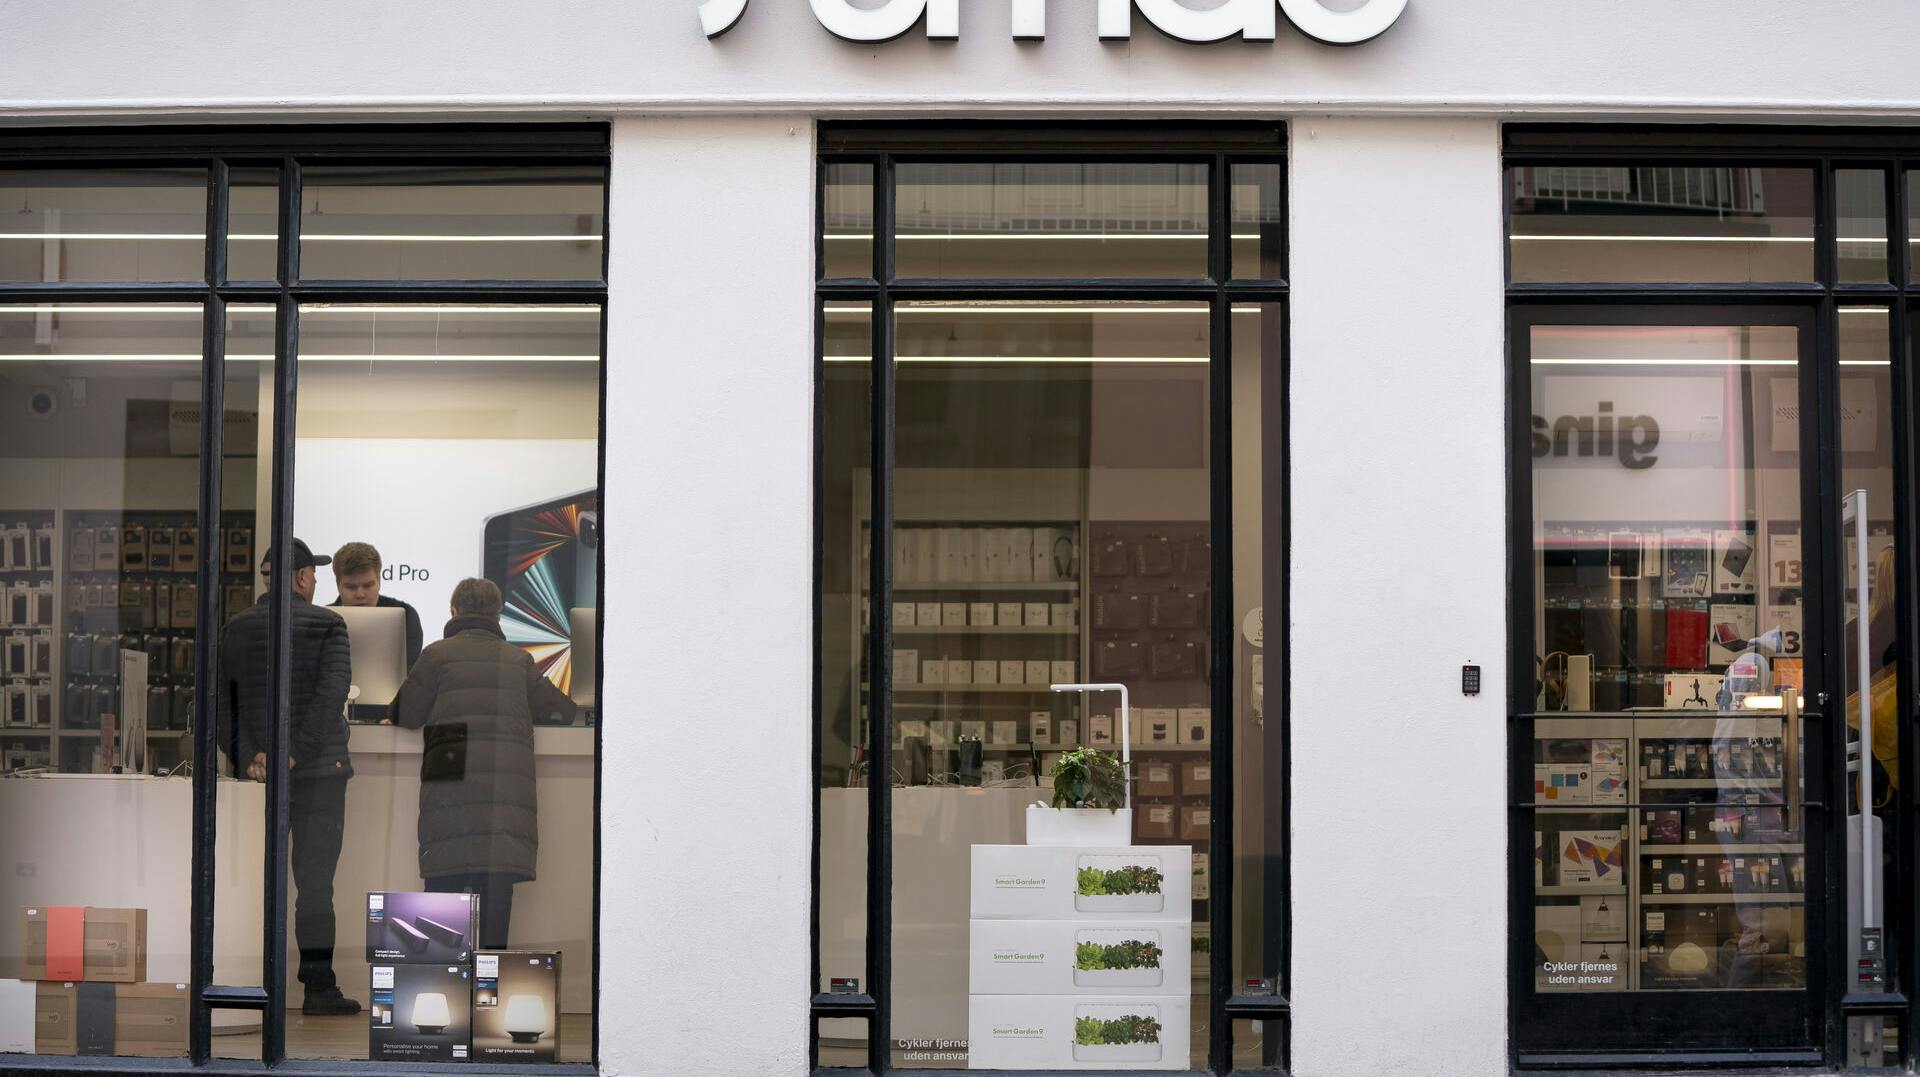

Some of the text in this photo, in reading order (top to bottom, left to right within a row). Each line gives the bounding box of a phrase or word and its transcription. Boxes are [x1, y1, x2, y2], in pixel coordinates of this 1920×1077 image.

[399, 564, 430, 581] Pro
[1774, 560, 1801, 583] 13
[993, 952, 1013, 960] Smart
[1014, 952, 1039, 960] Garden
[1543, 961, 1618, 973] Cykler fjernes
[1548, 974, 1614, 984] uden ansvar
[898, 1038, 969, 1050] Cykler fjerne
[903, 1051, 969, 1061] uden ansvar
